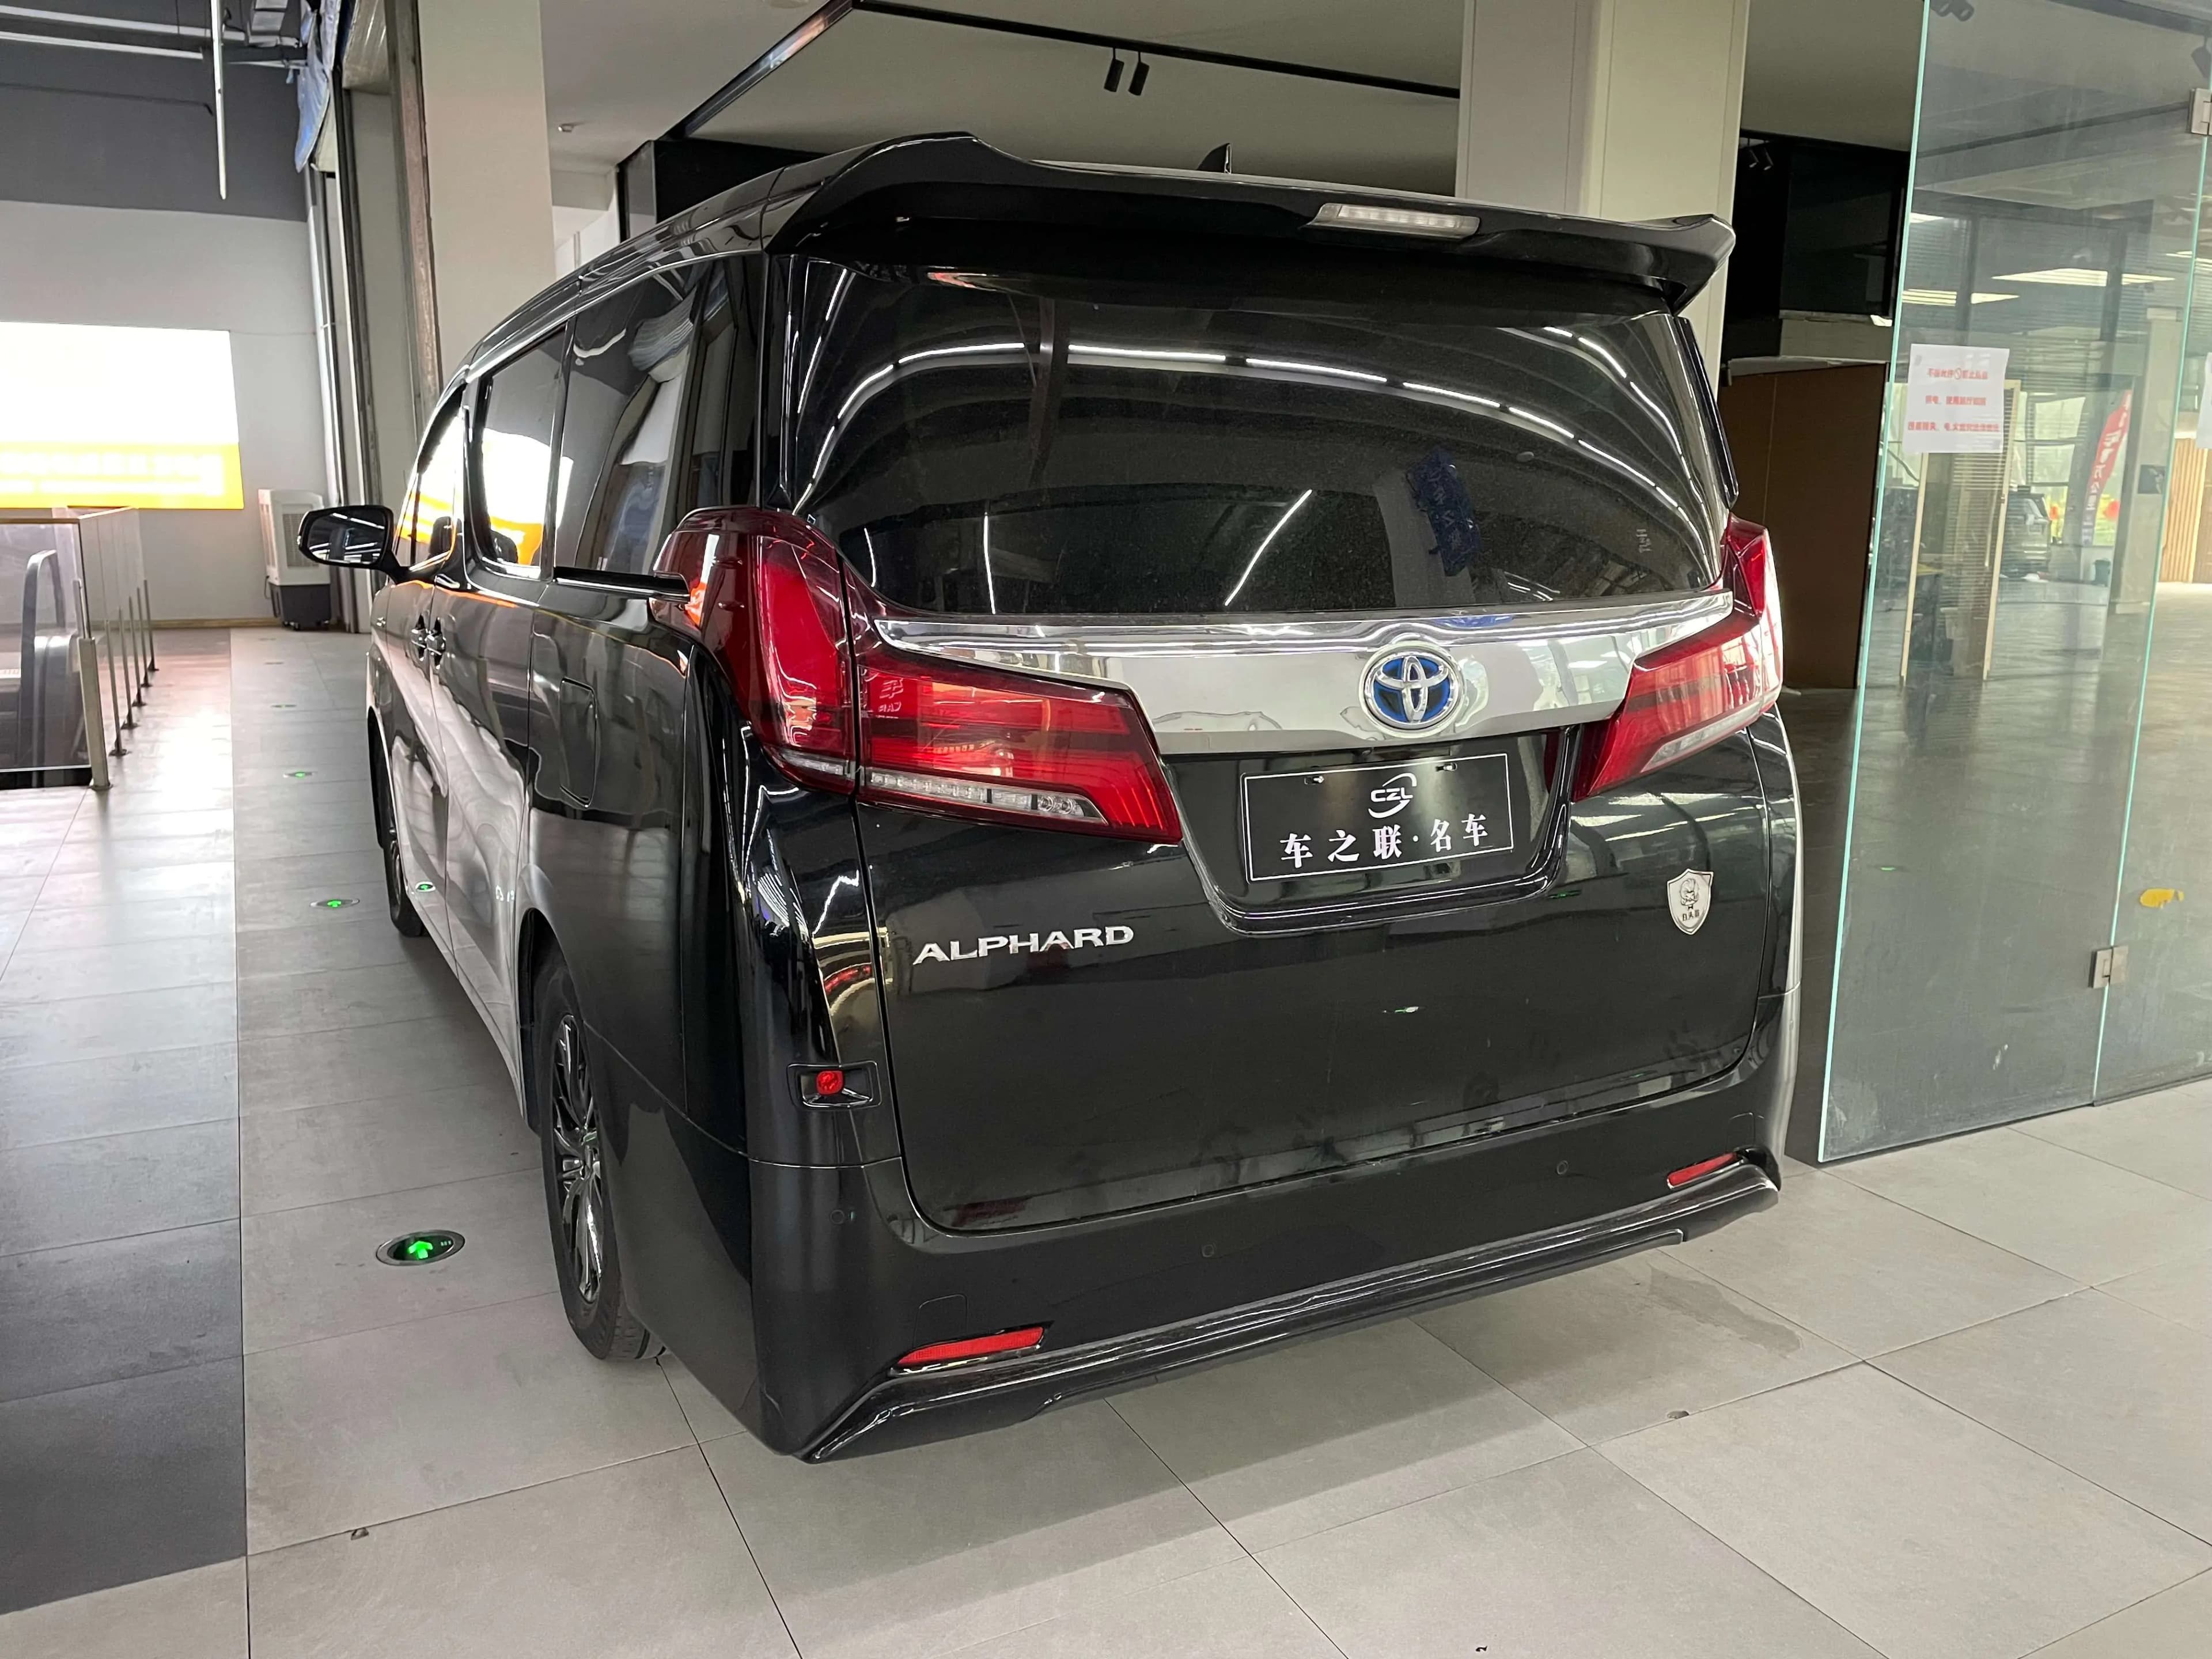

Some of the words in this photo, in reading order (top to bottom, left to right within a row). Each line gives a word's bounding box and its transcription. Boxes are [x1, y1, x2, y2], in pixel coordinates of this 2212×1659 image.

[1370, 786, 1413, 802] CZL
[1279, 813, 1488, 869] 车之联·名车
[912, 925, 1135, 965] ALPHARD
